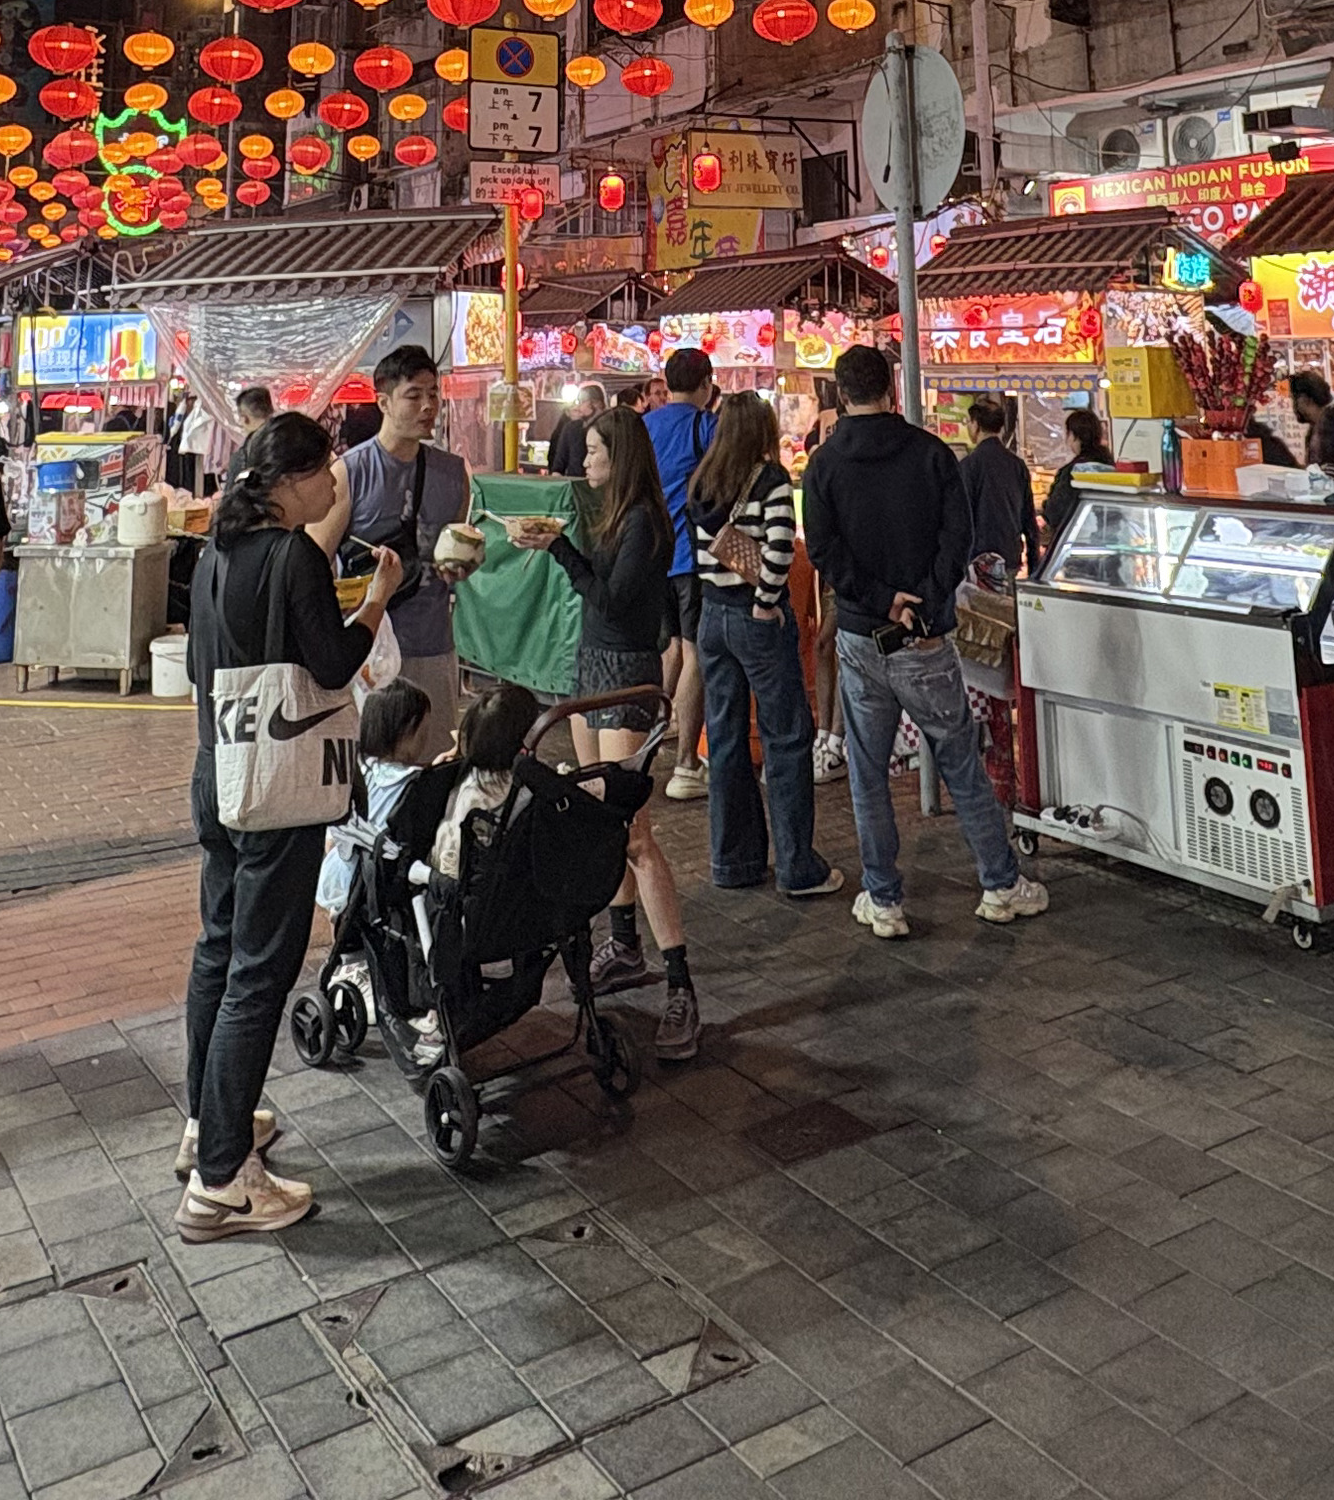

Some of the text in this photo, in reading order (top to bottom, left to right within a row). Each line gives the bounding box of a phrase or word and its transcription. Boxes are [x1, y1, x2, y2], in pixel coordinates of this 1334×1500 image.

[493, 87, 509, 96] am
[488, 91, 543, 113] 上午 7
[492, 122, 509, 131] pm
[488, 125, 543, 148] 下午 7
[491, 165, 540, 176] Except taxi
[480, 176, 499, 186] pick
[537, 177, 551, 186] off
[1091, 156, 1310, 200] MEXICAN INDIAN FUSION
[475, 187, 556, 201] 的士上落外
[734, 183, 783, 194] JEWELLERY
